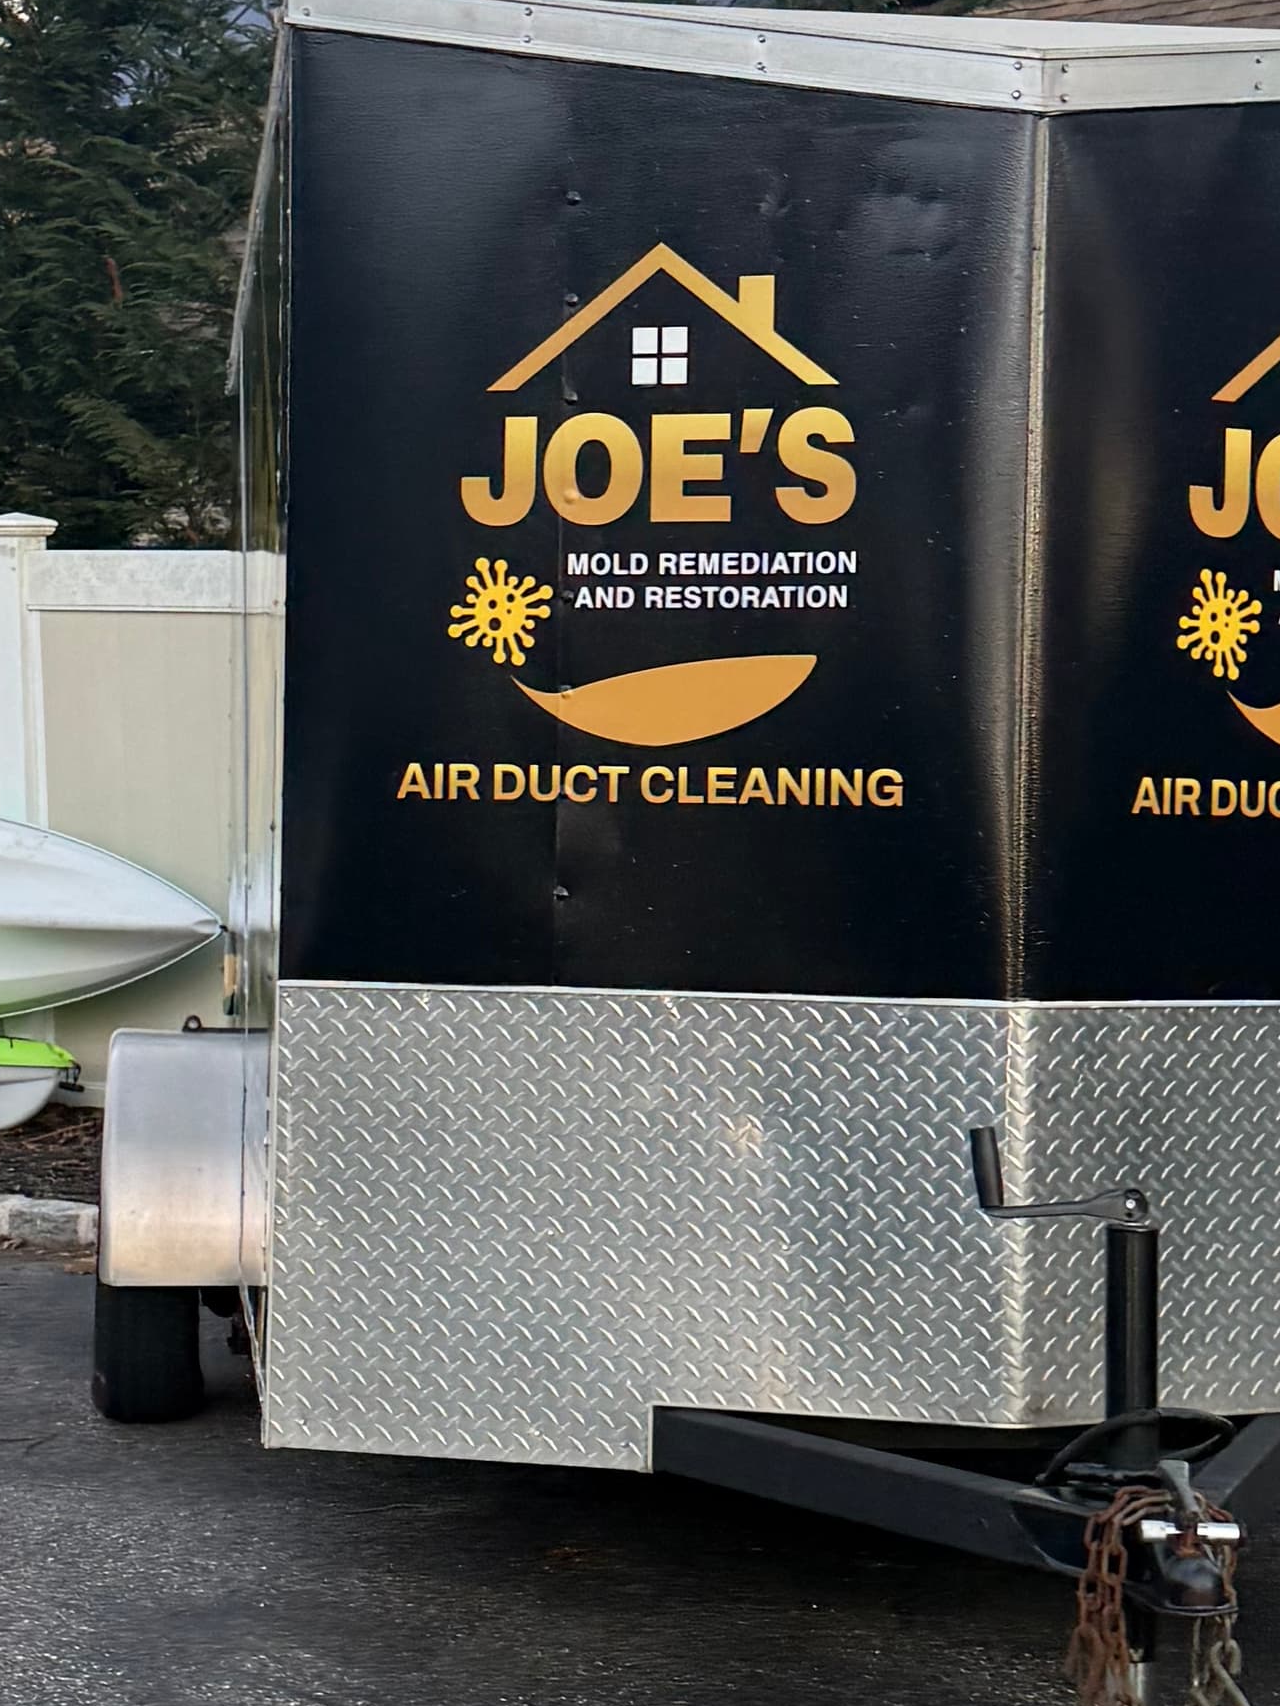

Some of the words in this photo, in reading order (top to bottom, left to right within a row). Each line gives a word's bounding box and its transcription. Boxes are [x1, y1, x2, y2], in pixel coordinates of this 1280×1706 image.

[461, 407, 856, 526] JOE'S
[567, 552, 648, 575] MOLD
[659, 551, 856, 575] REMEDIATION
[574, 586, 635, 609] AND
[644, 585, 848, 609] RESTORATION
[397, 762, 480, 800] AIR
[493, 763, 630, 803] DUCT
[640, 765, 904, 807] CLEANING
[1131, 776, 1200, 816] AIR
